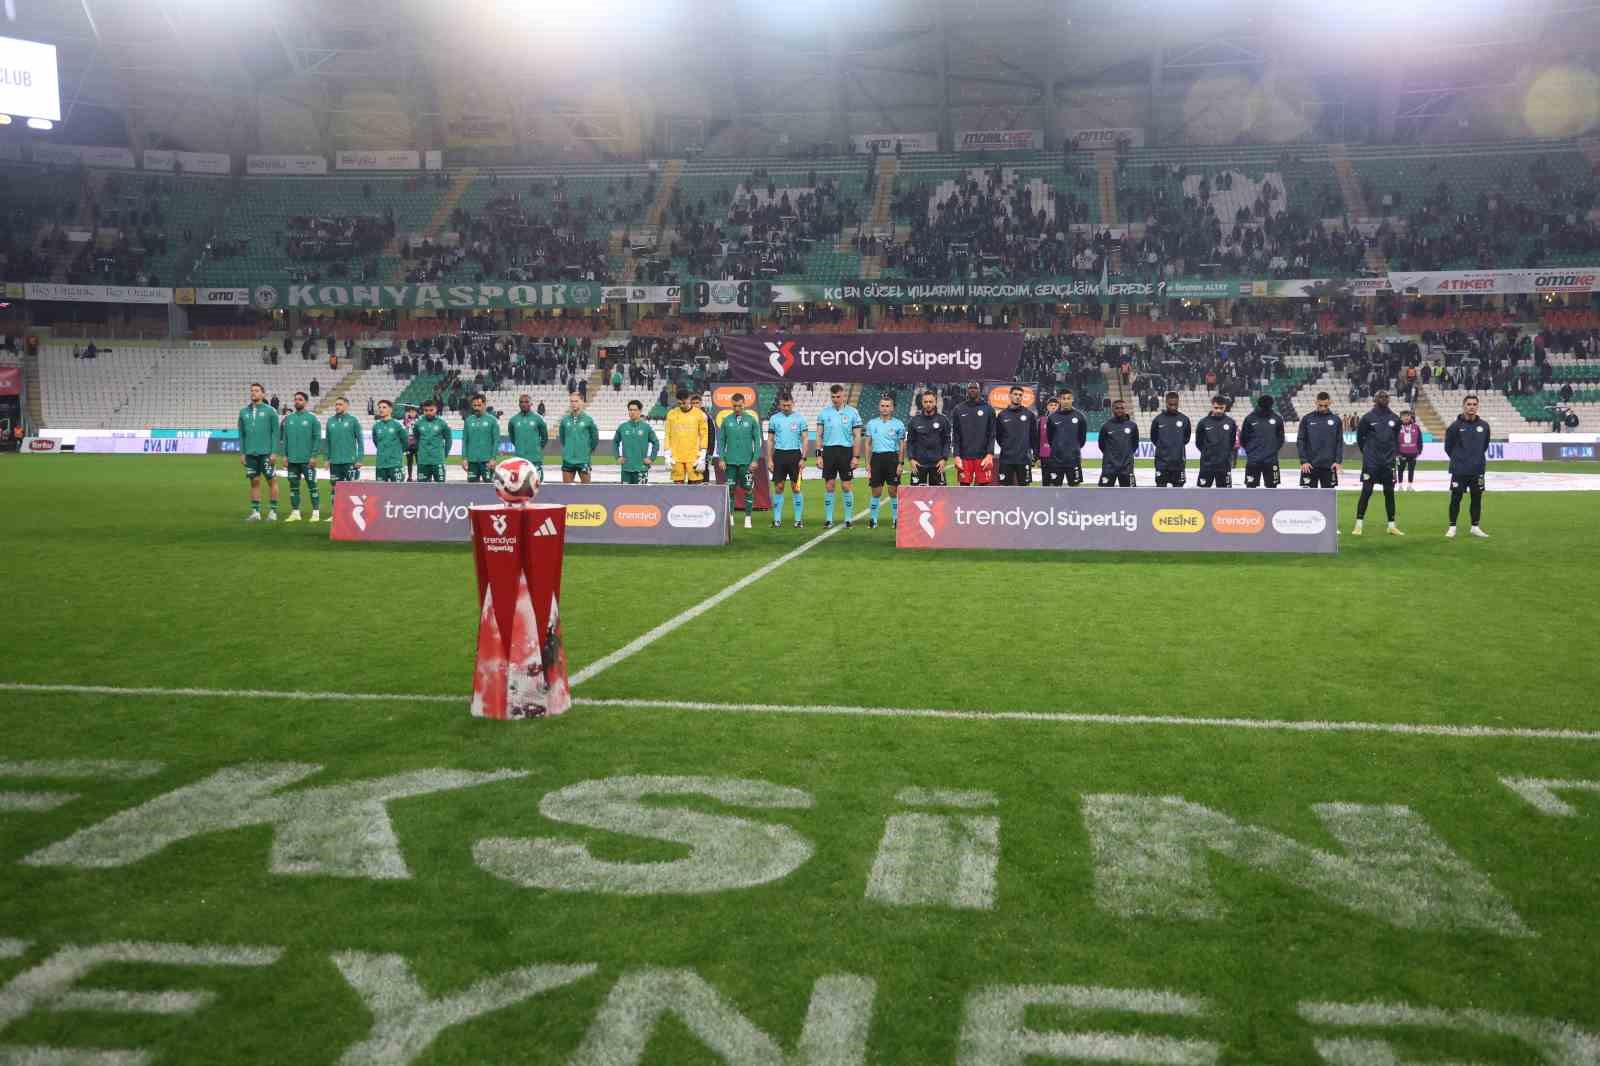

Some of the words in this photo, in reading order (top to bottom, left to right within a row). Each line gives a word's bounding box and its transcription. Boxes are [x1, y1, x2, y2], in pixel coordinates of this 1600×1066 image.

[288, 284, 567, 308] KONYASPOR
[799, 346, 899, 370] trendyol
[901, 348, 982, 370] SüperLig
[384, 501, 474, 524] trendyo
[954, 506, 1054, 530] trendyol
[1057, 510, 1138, 531] SüperLig
[483, 536, 517, 545] trendyol
